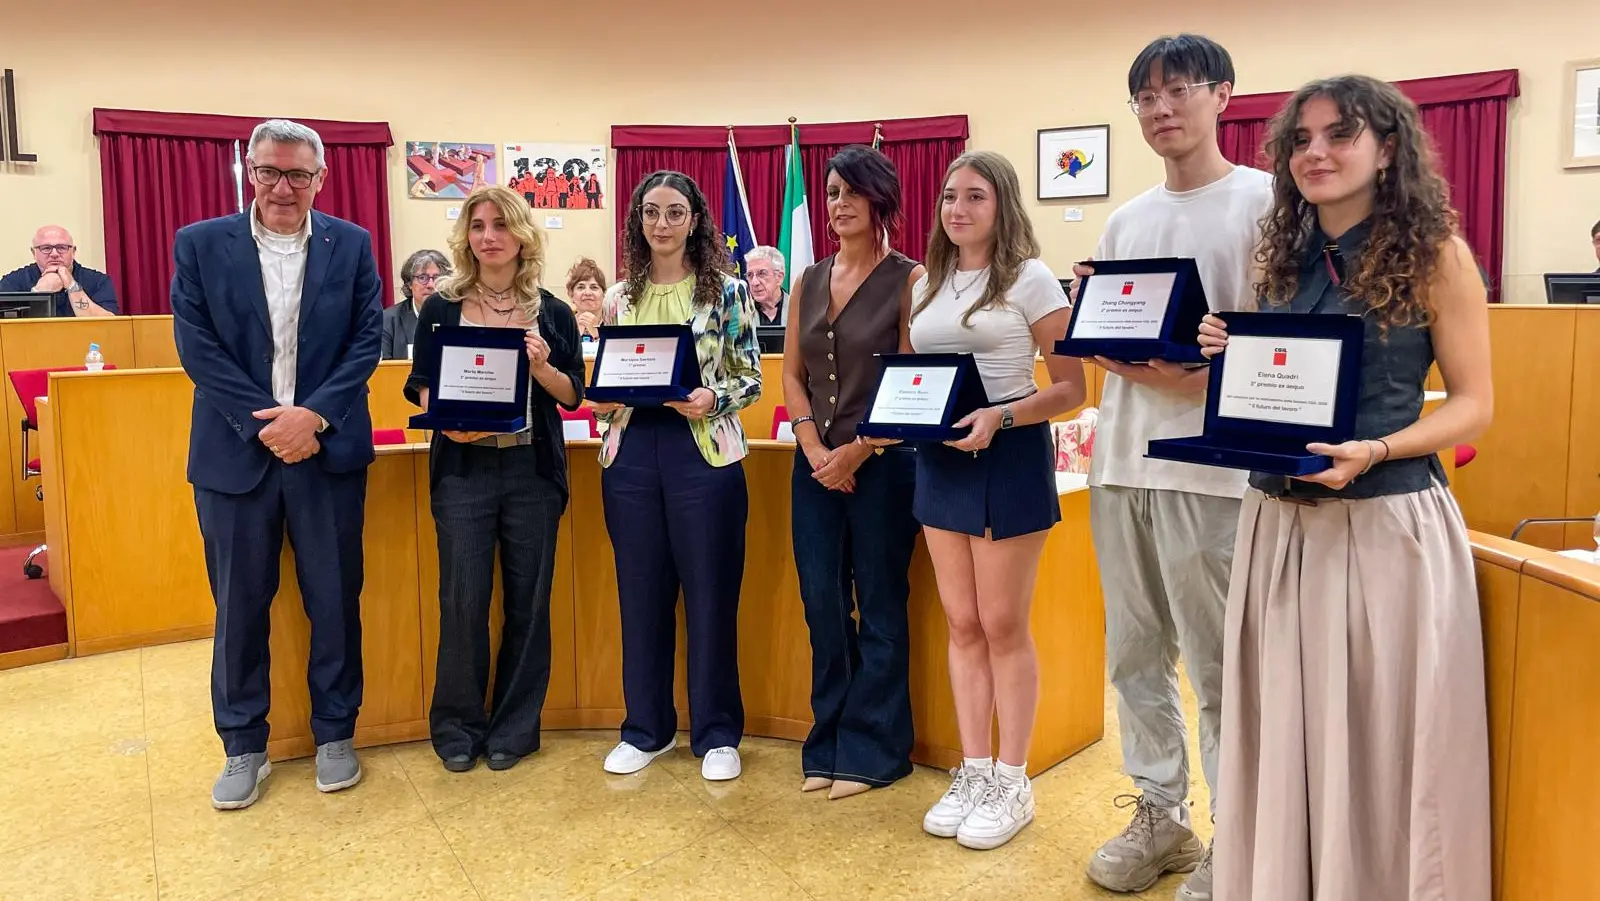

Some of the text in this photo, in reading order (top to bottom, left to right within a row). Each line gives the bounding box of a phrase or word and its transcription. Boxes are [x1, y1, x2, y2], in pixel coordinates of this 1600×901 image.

[0, 69, 38, 162] L
[1257, 371, 1299, 380] Elena Quadri
